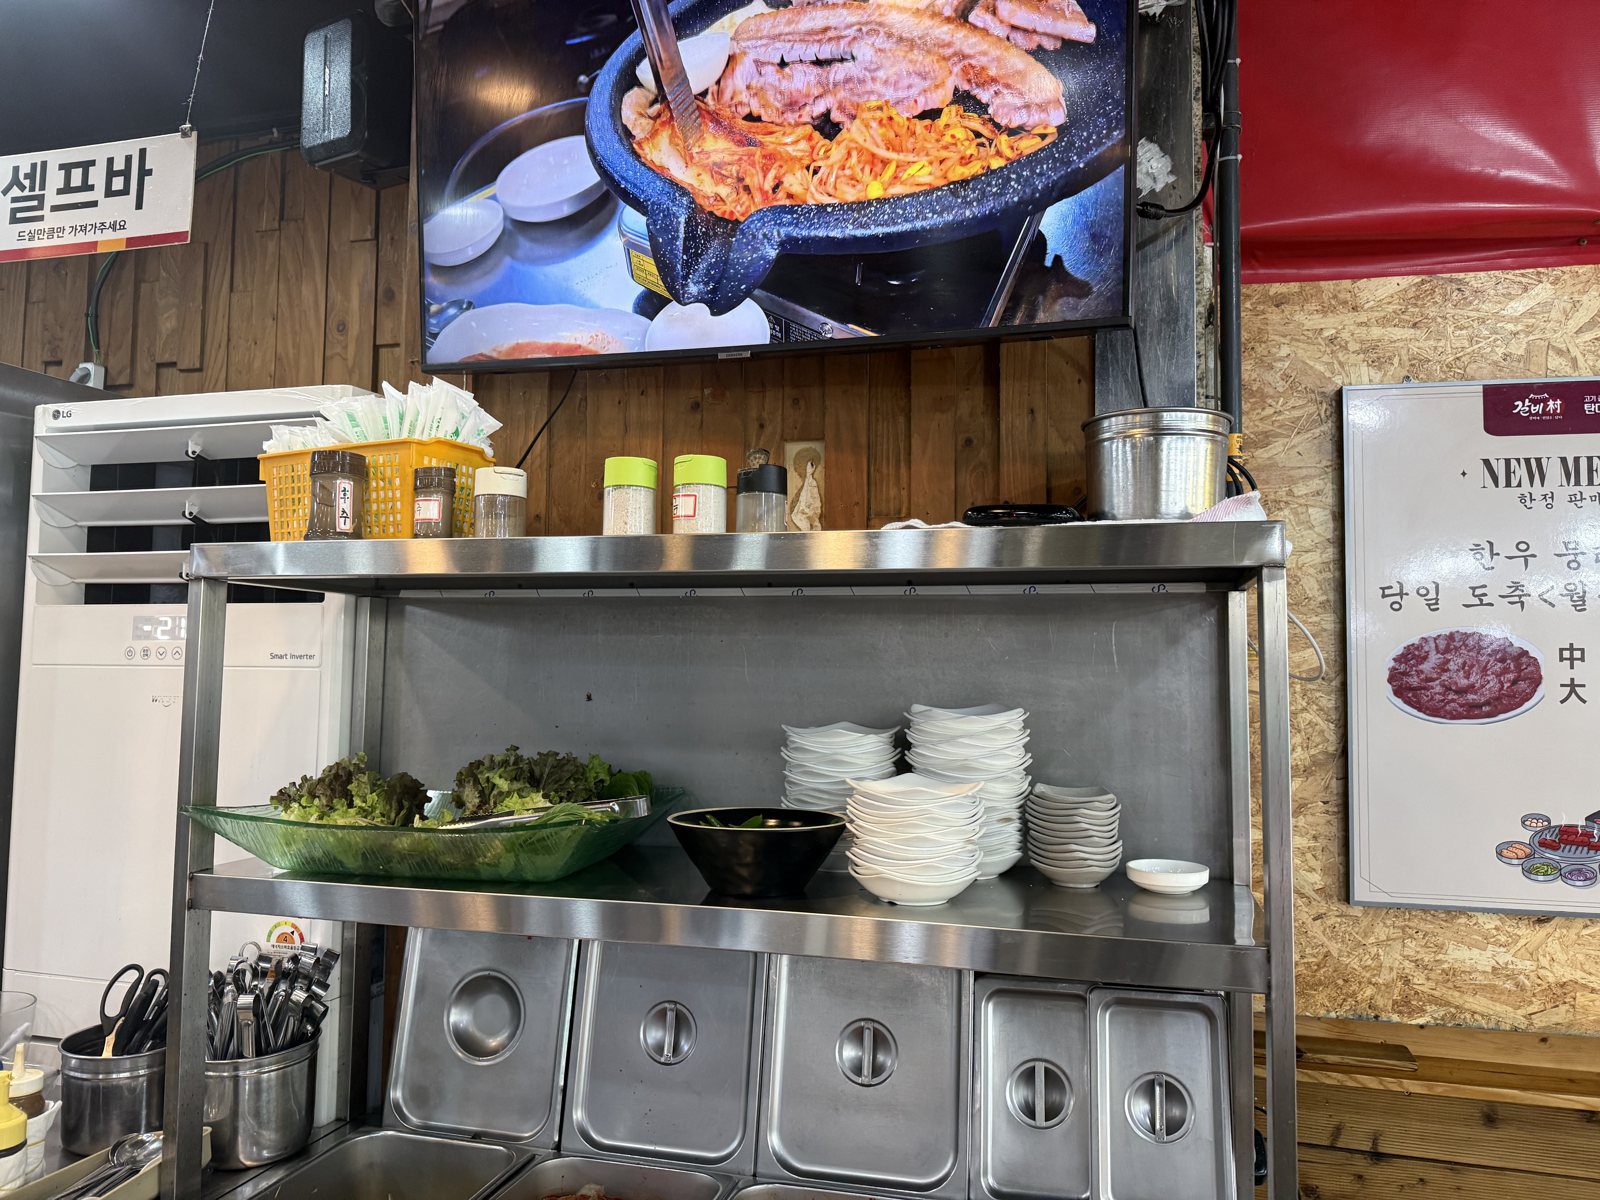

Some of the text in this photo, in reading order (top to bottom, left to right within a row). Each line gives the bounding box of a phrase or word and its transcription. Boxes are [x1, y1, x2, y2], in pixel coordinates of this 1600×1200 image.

[1, 147, 153, 225] 셀프바
[16, 219, 127, 242] 드실만큼만 가져가주세요
[61, 410, 72, 418] LG
[1480, 457, 1552, 489] NEW
[1517, 491, 1554, 510] 한정
[1468, 540, 1537, 572] 한우
[1379, 581, 1441, 612] 당일
[269, 652, 316, 660] Smart Inverter
[1558, 642, 1586, 670] 中
[1559, 678, 1587, 705] 大
[283, 935, 288, 943] 4
